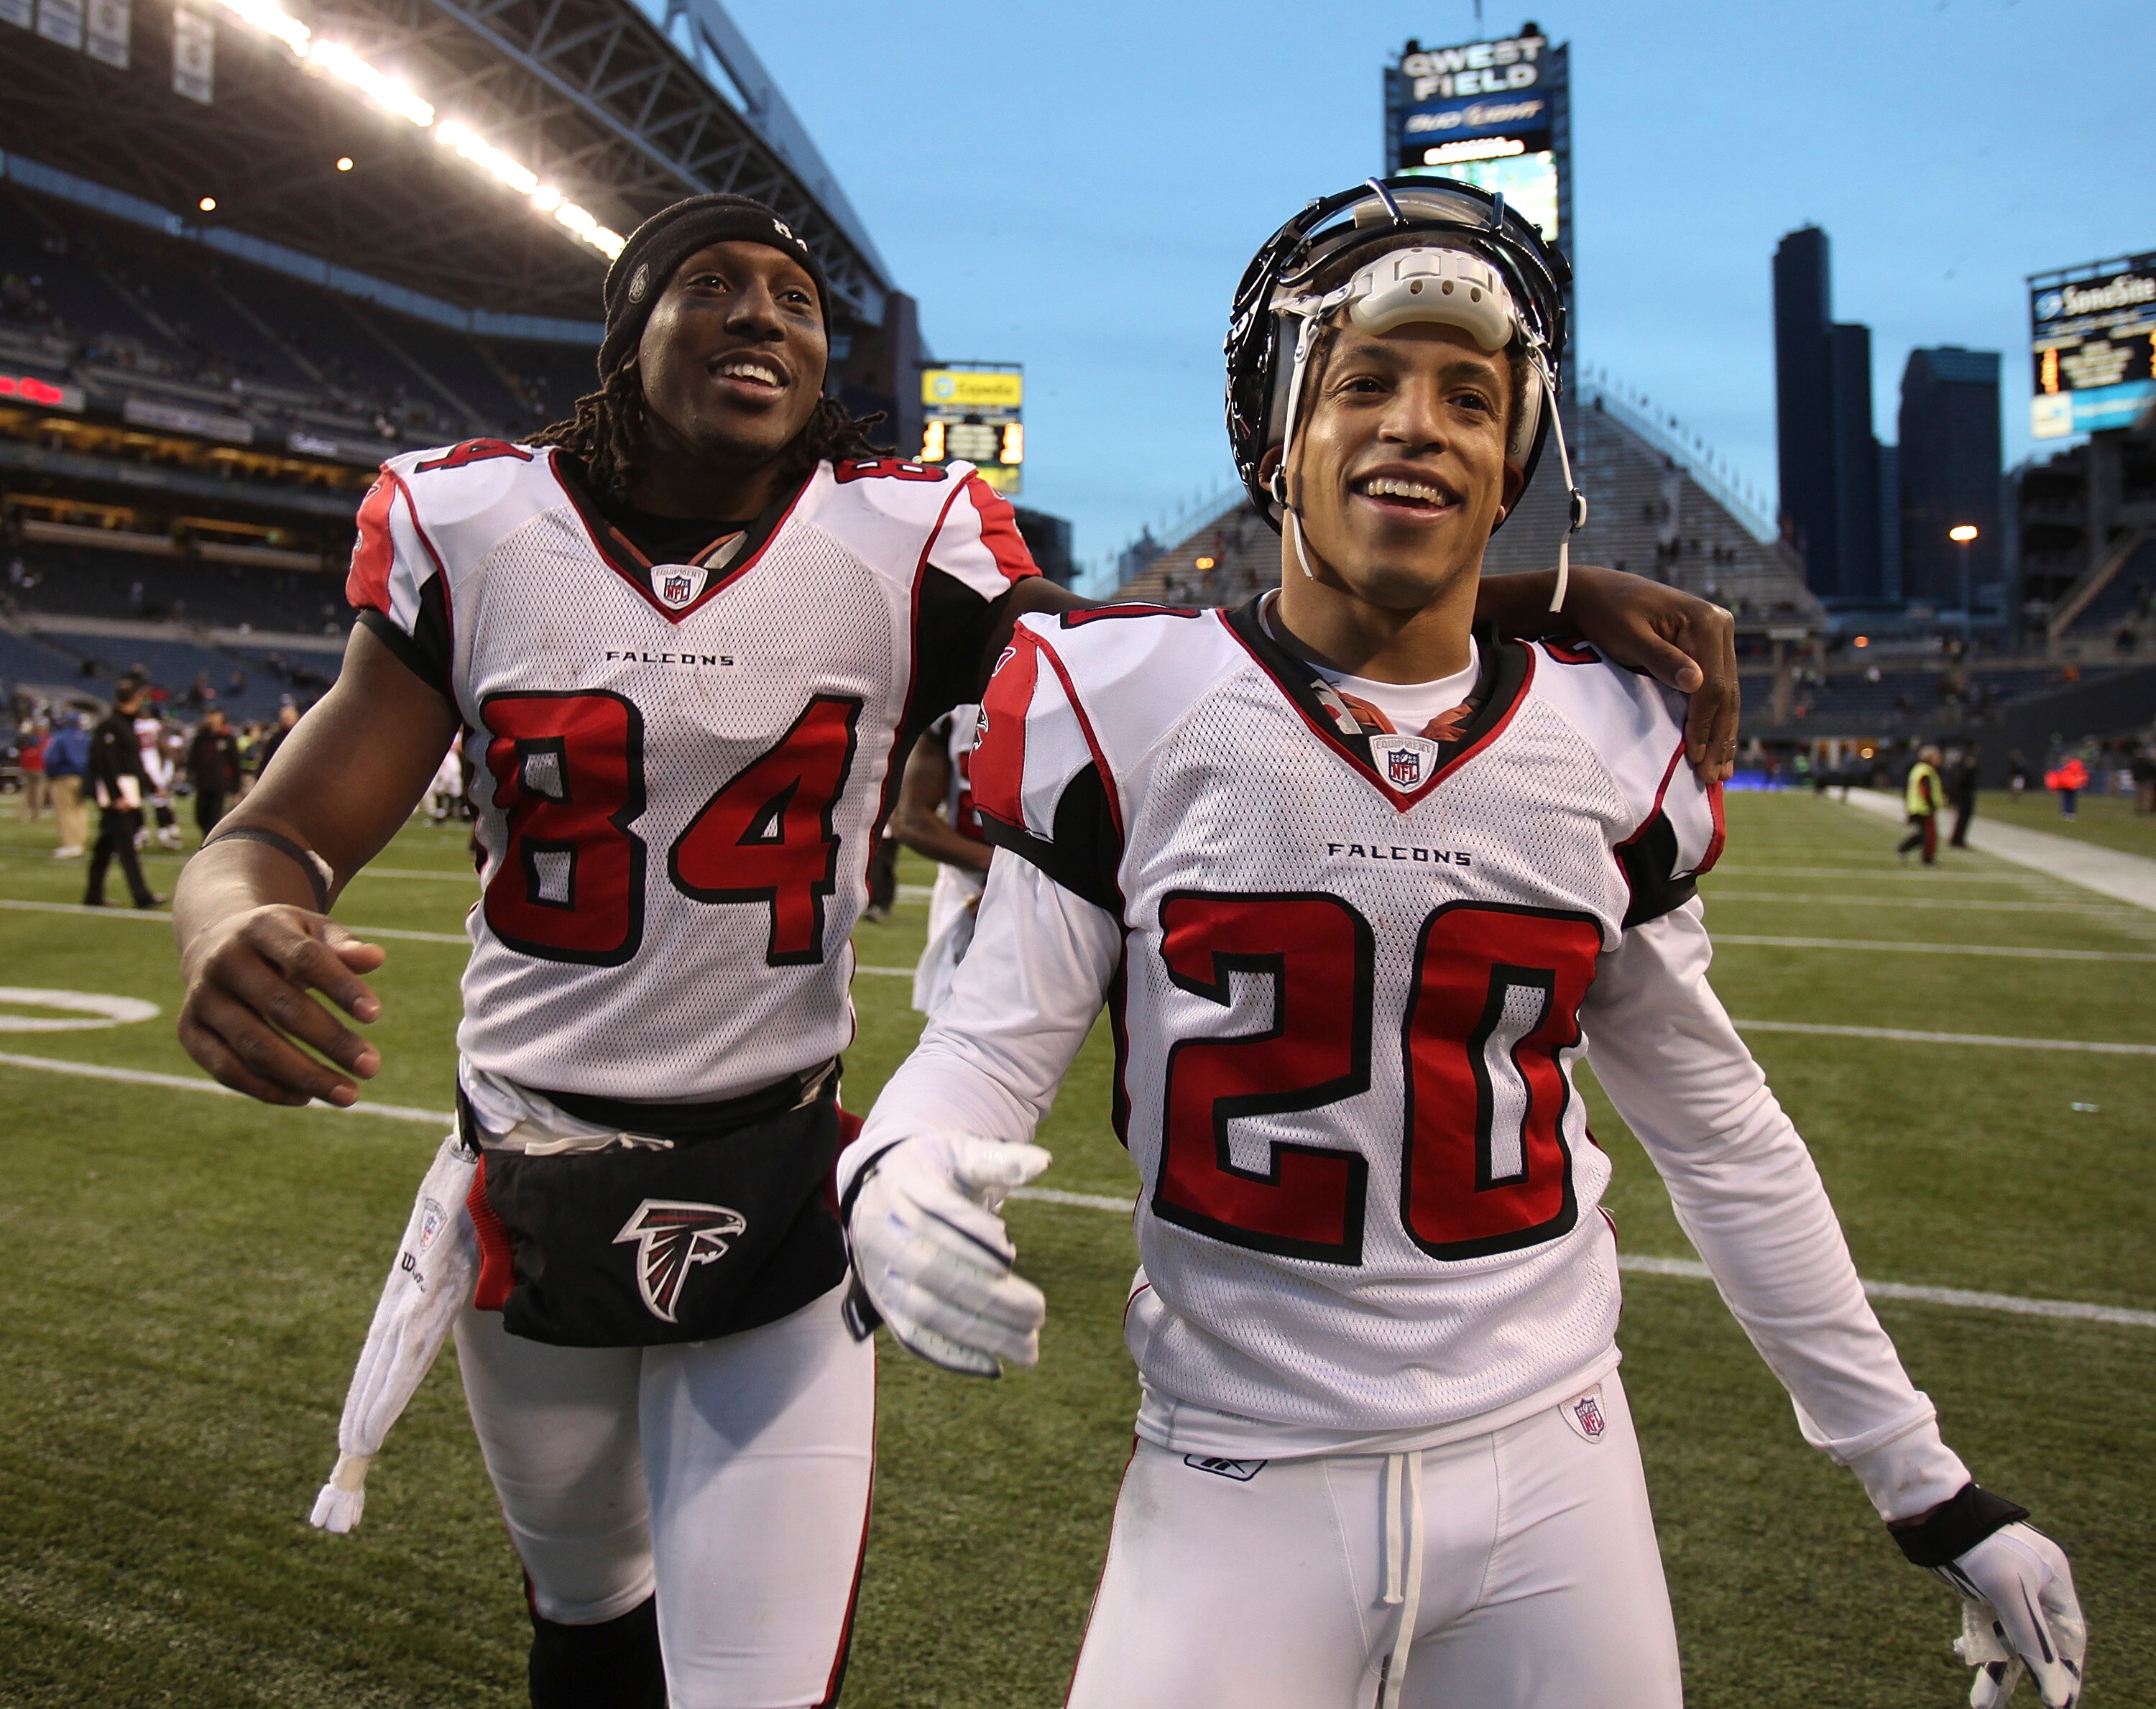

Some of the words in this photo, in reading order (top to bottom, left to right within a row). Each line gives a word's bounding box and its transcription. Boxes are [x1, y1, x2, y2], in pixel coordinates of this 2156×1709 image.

[1404, 37, 1546, 78] QWEST
[1413, 63, 1538, 101] FIELD
[667, 586, 687, 600] NFL
[605, 651, 734, 666] FALCONS
[1376, 739, 1432, 754] EQUIPMENT
[1391, 764, 1417, 782] NFL
[480, 688, 864, 967] 84
[1327, 842, 1472, 867] FALCONS
[1151, 890, 1604, 1266] 20
[1582, 1411, 1603, 1432] NFL
